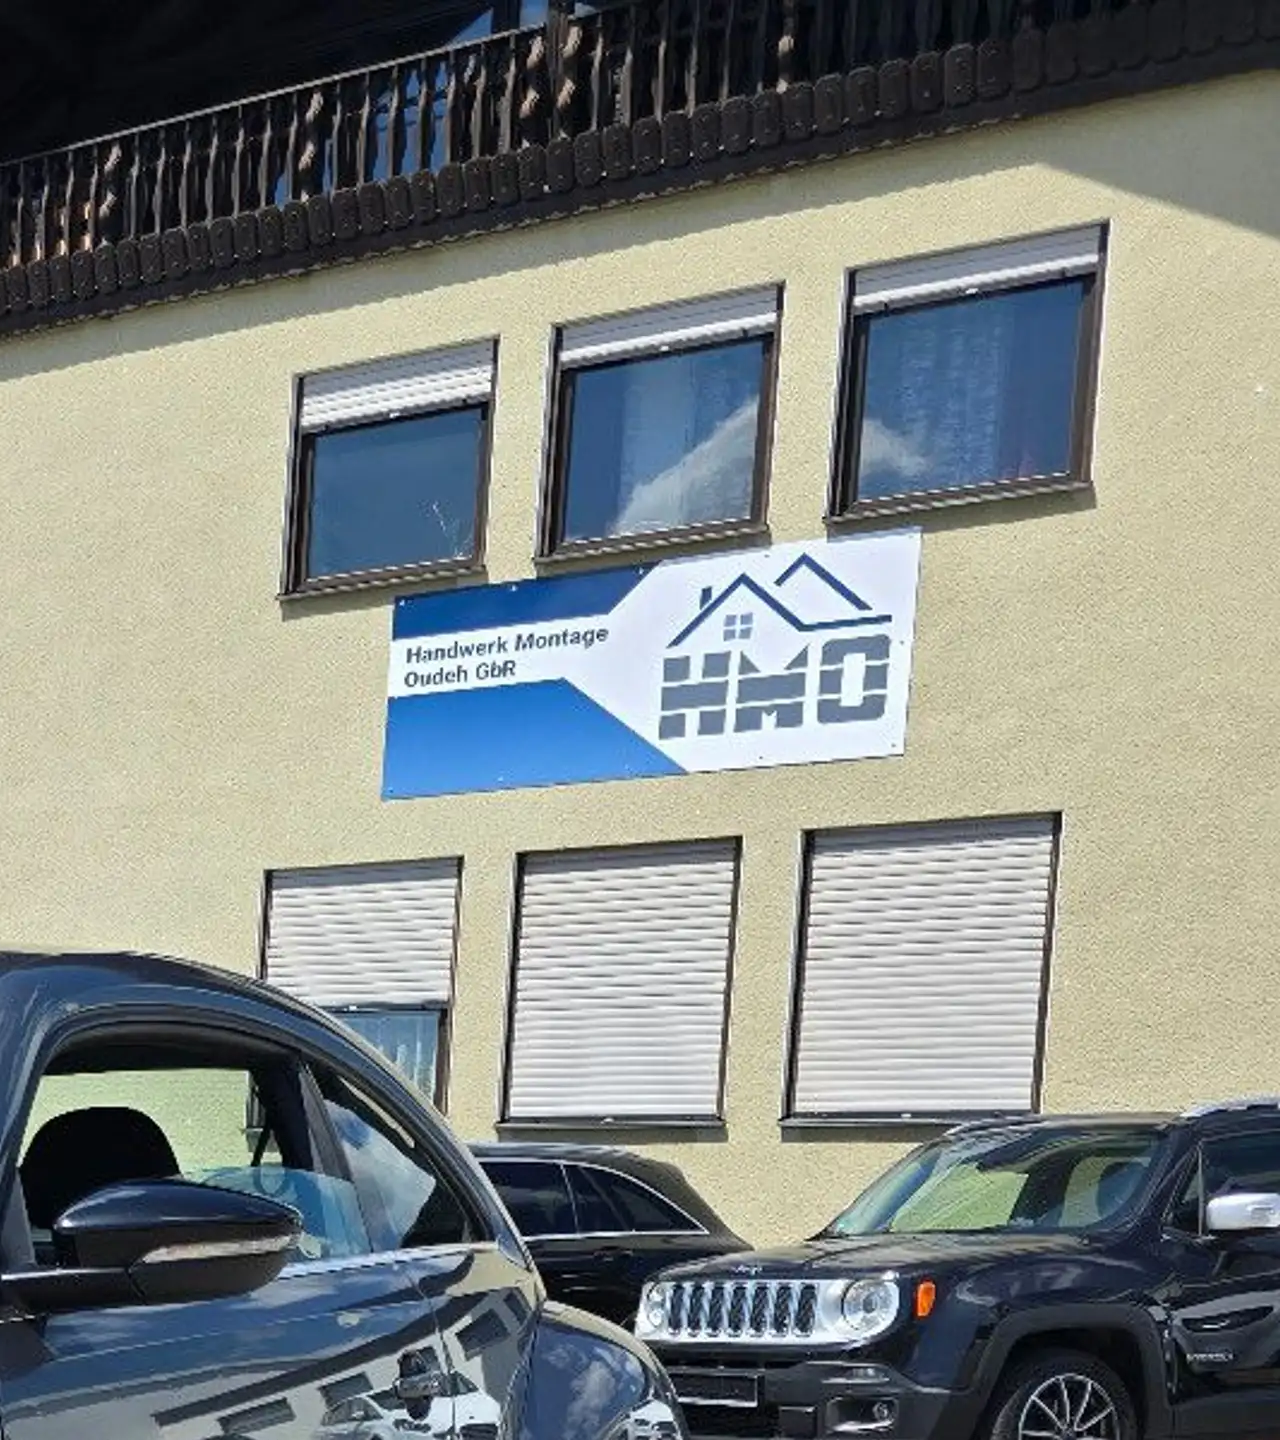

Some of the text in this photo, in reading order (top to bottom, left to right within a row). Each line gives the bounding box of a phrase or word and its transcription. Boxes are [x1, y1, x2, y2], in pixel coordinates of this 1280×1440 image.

[406, 628, 609, 663] Handwerk Montage
[404, 660, 516, 688] Oudeh GbR
[658, 634, 890, 740] HMO
